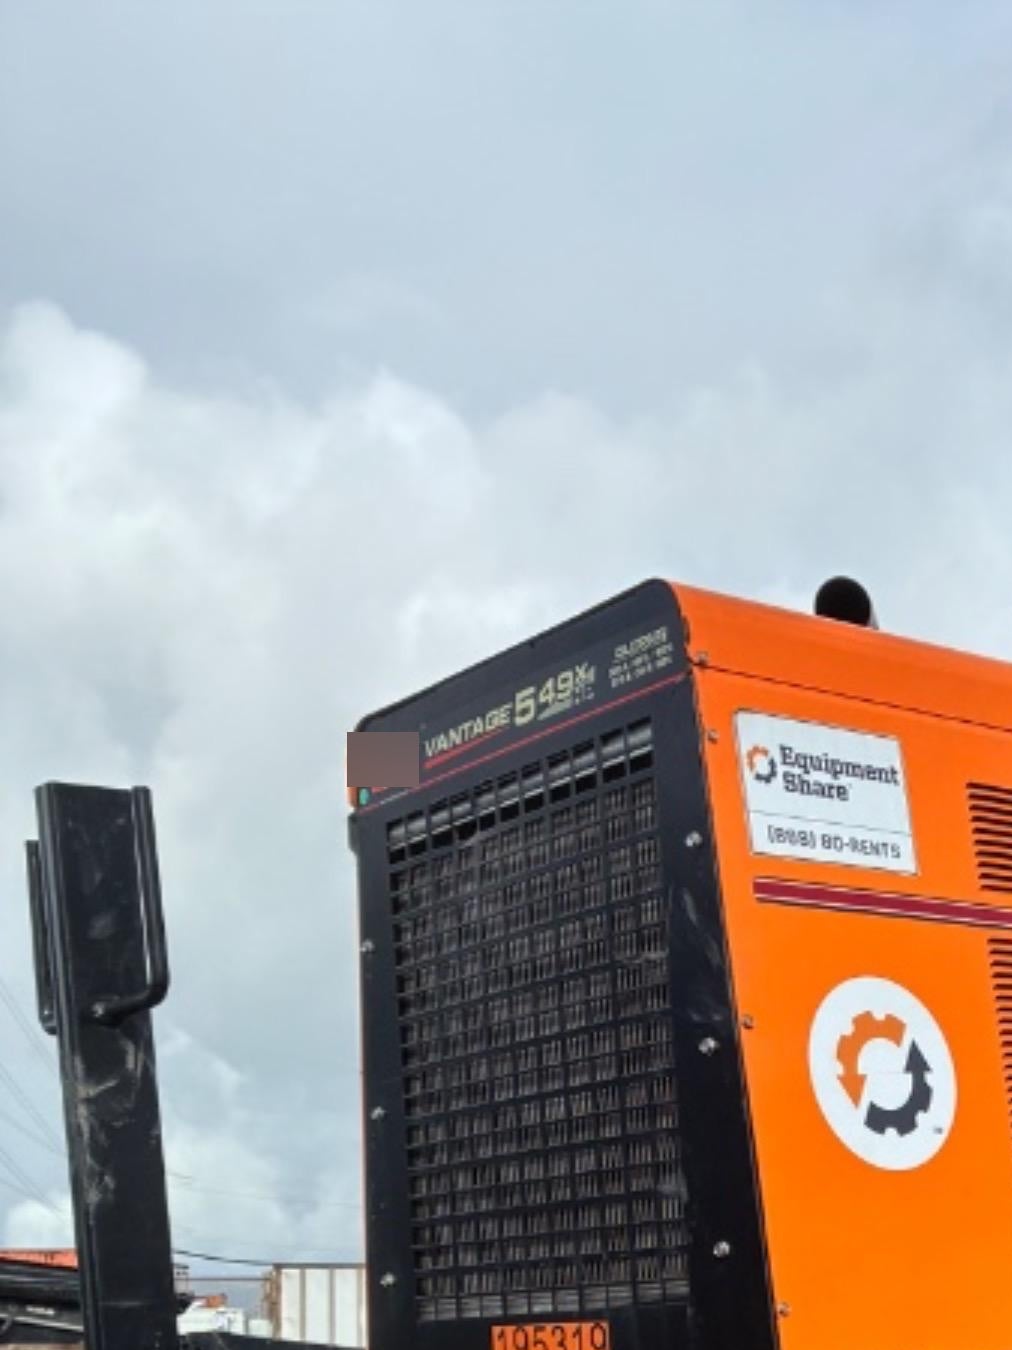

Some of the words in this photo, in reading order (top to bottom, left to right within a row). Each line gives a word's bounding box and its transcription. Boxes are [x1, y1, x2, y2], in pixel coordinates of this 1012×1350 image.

[425, 703, 512, 757] VANTAGE
[781, 745, 899, 785] Equipment
[783, 771, 849, 801] Share
[767, 825, 817, 849] (888)
[821, 834, 901, 858] 80-RENTS
